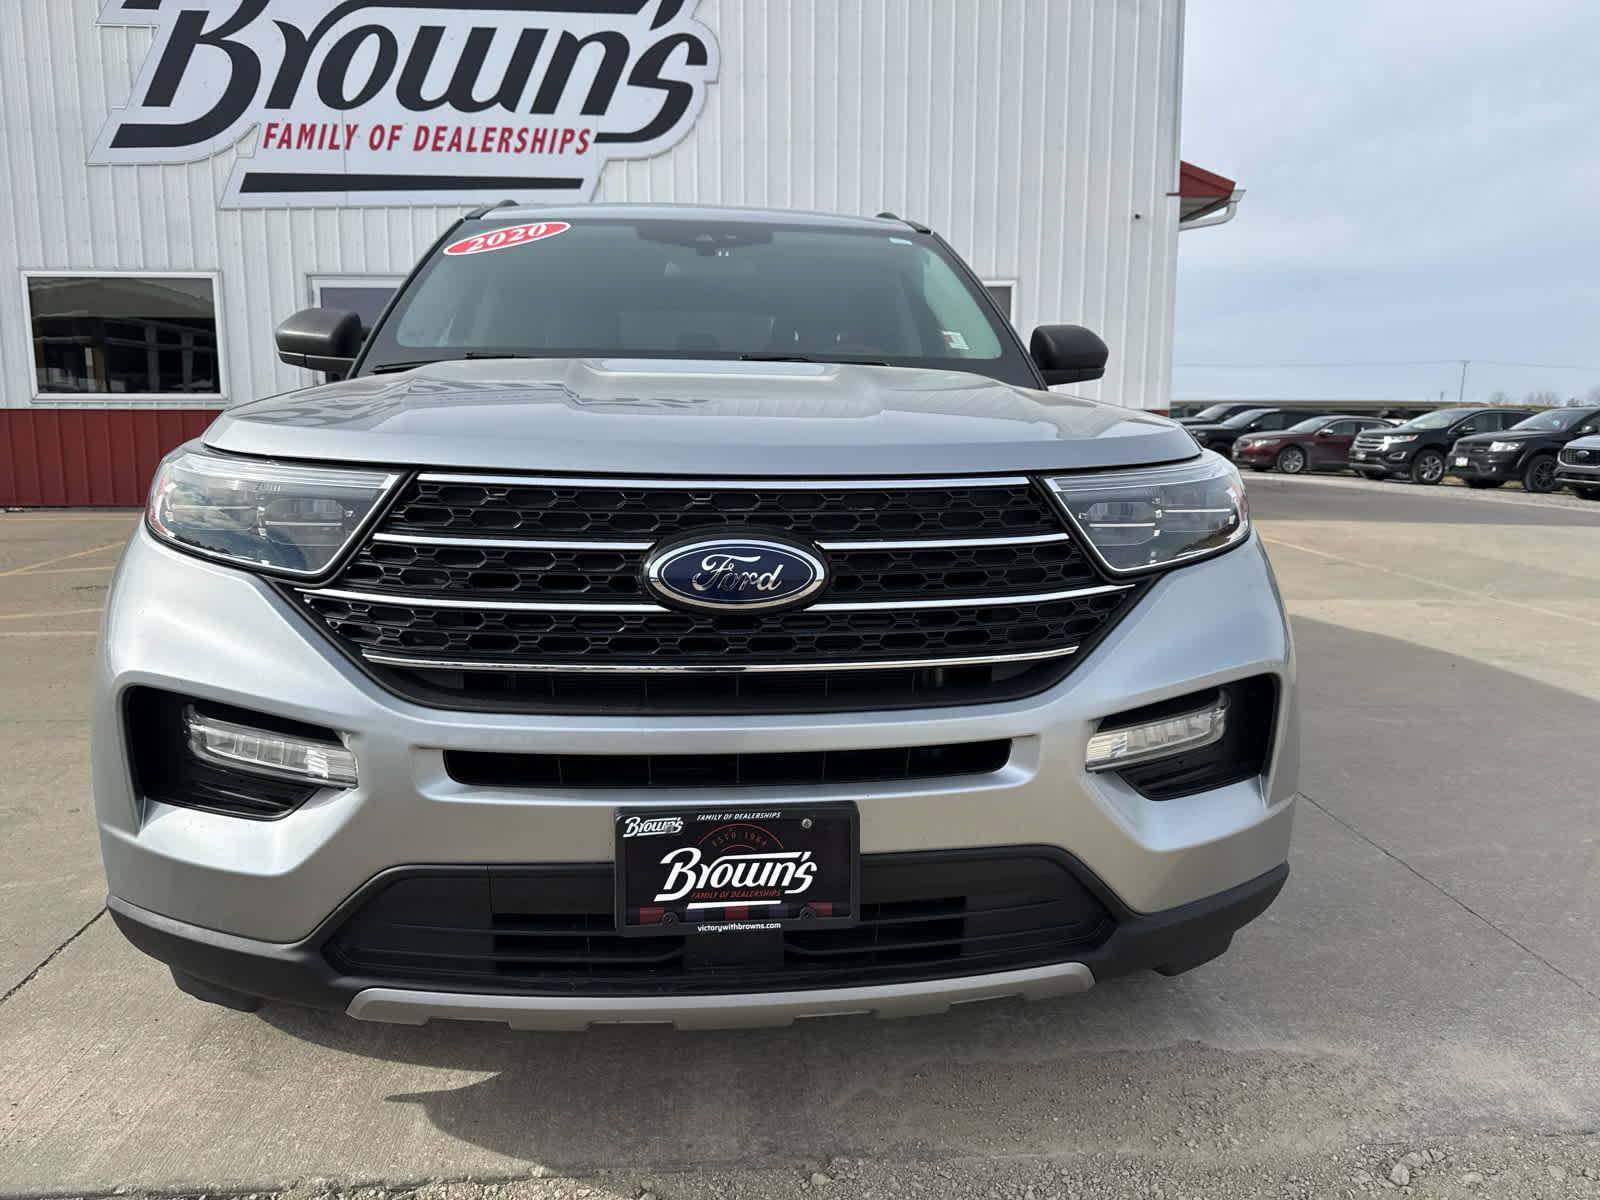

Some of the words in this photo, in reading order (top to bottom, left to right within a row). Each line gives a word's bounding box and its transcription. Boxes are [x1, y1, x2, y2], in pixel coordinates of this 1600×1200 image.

[106, 0, 708, 148] Brown's
[263, 122, 358, 150] FAMILY
[368, 124, 403, 151] OF
[412, 125, 592, 155] DEALERSHIPS
[466, 223, 548, 252] 2020
[692, 554, 784, 591] Ford
[734, 811, 782, 820] DEALERSHIPS
[654, 847, 817, 902] Brown's
[691, 890, 718, 899] FAMILY
[719, 890, 729, 898] OF
[730, 888, 781, 898] DEALERSHIPS
[697, 922, 782, 933] victorywithbrowns.com
